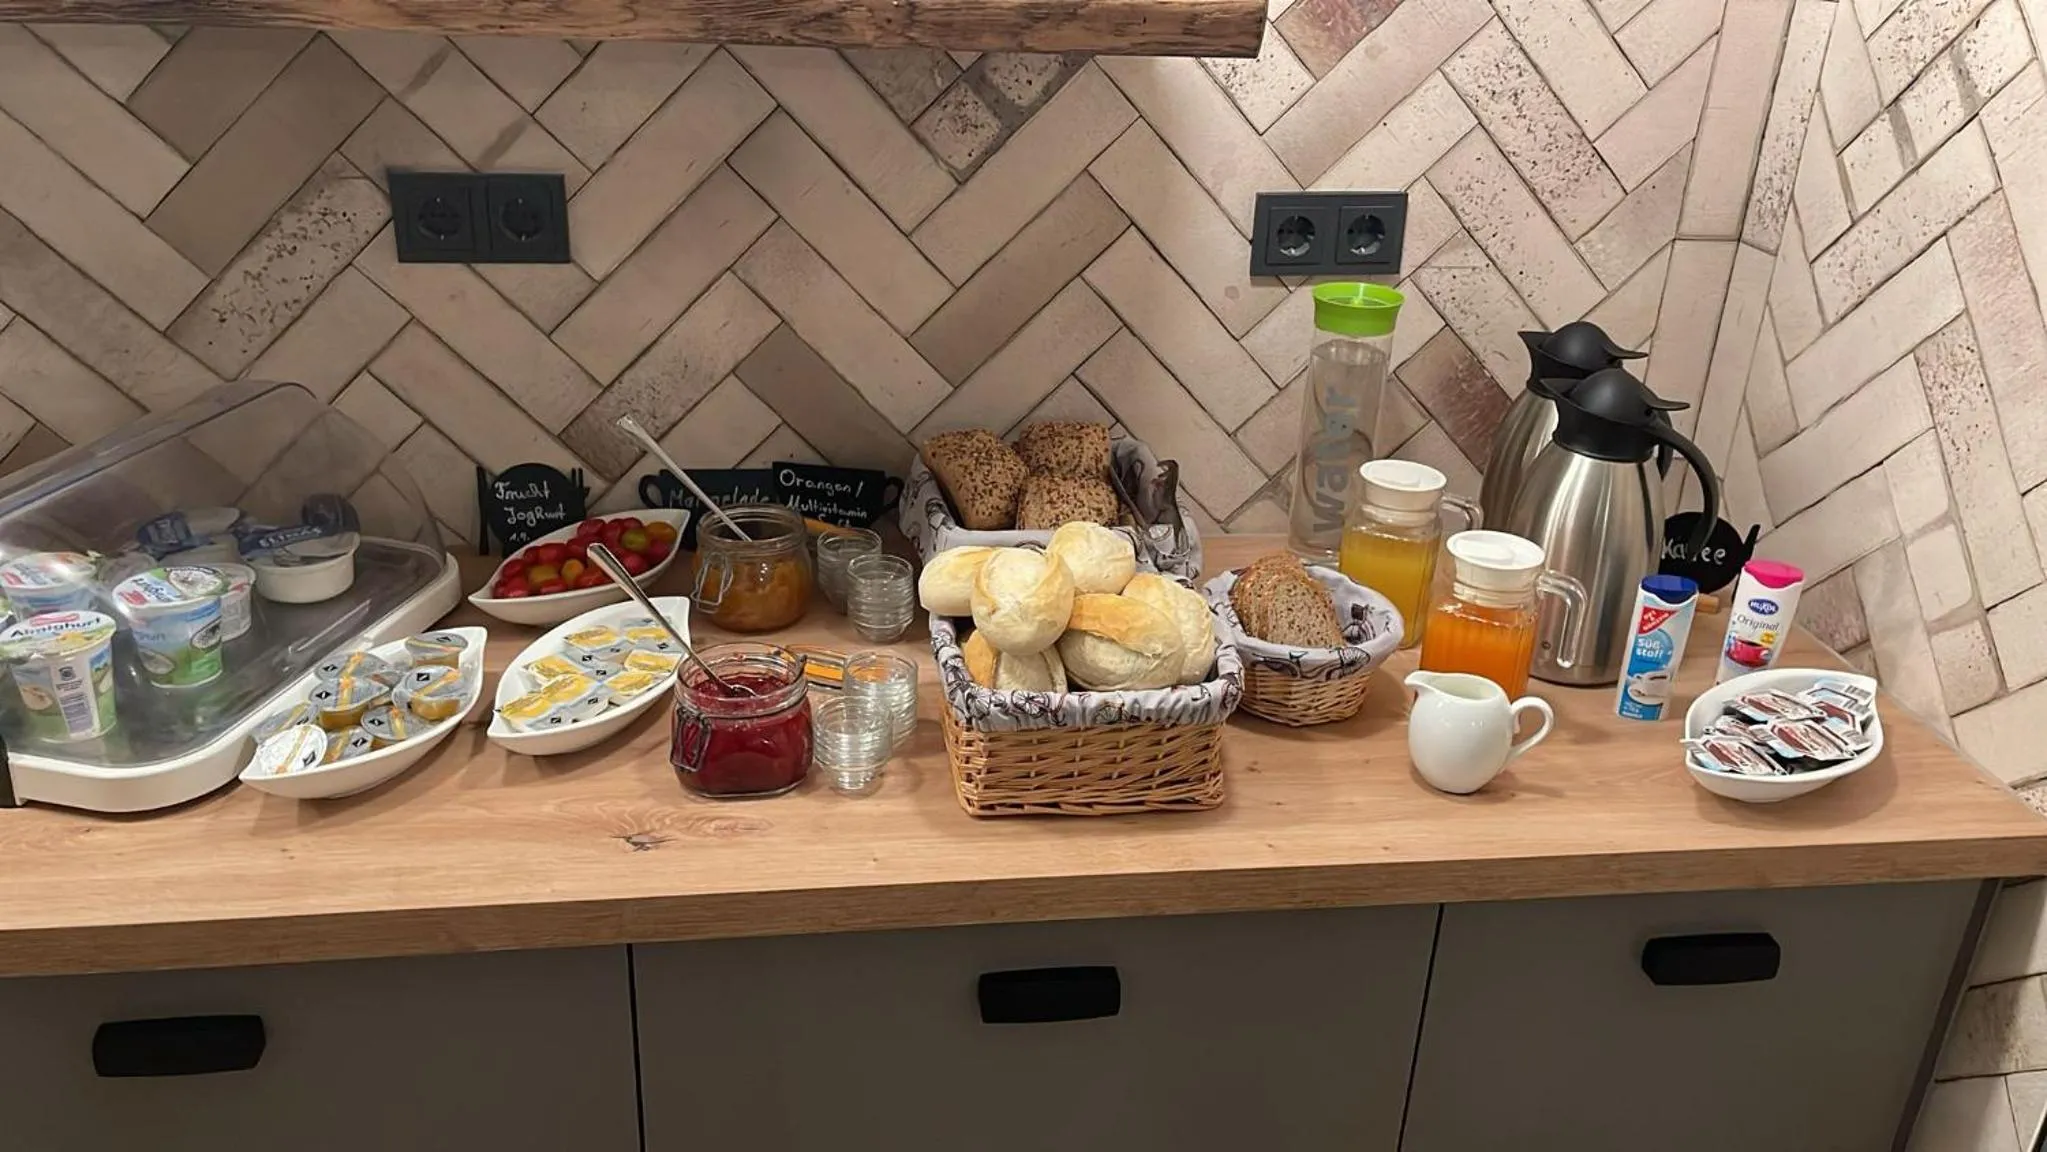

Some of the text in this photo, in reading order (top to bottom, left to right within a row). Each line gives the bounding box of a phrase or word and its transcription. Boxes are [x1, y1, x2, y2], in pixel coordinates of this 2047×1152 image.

[780, 469, 851, 497] Orangen
[786, 494, 868, 519] Multivitamin
[1737, 614, 1780, 634] Original
